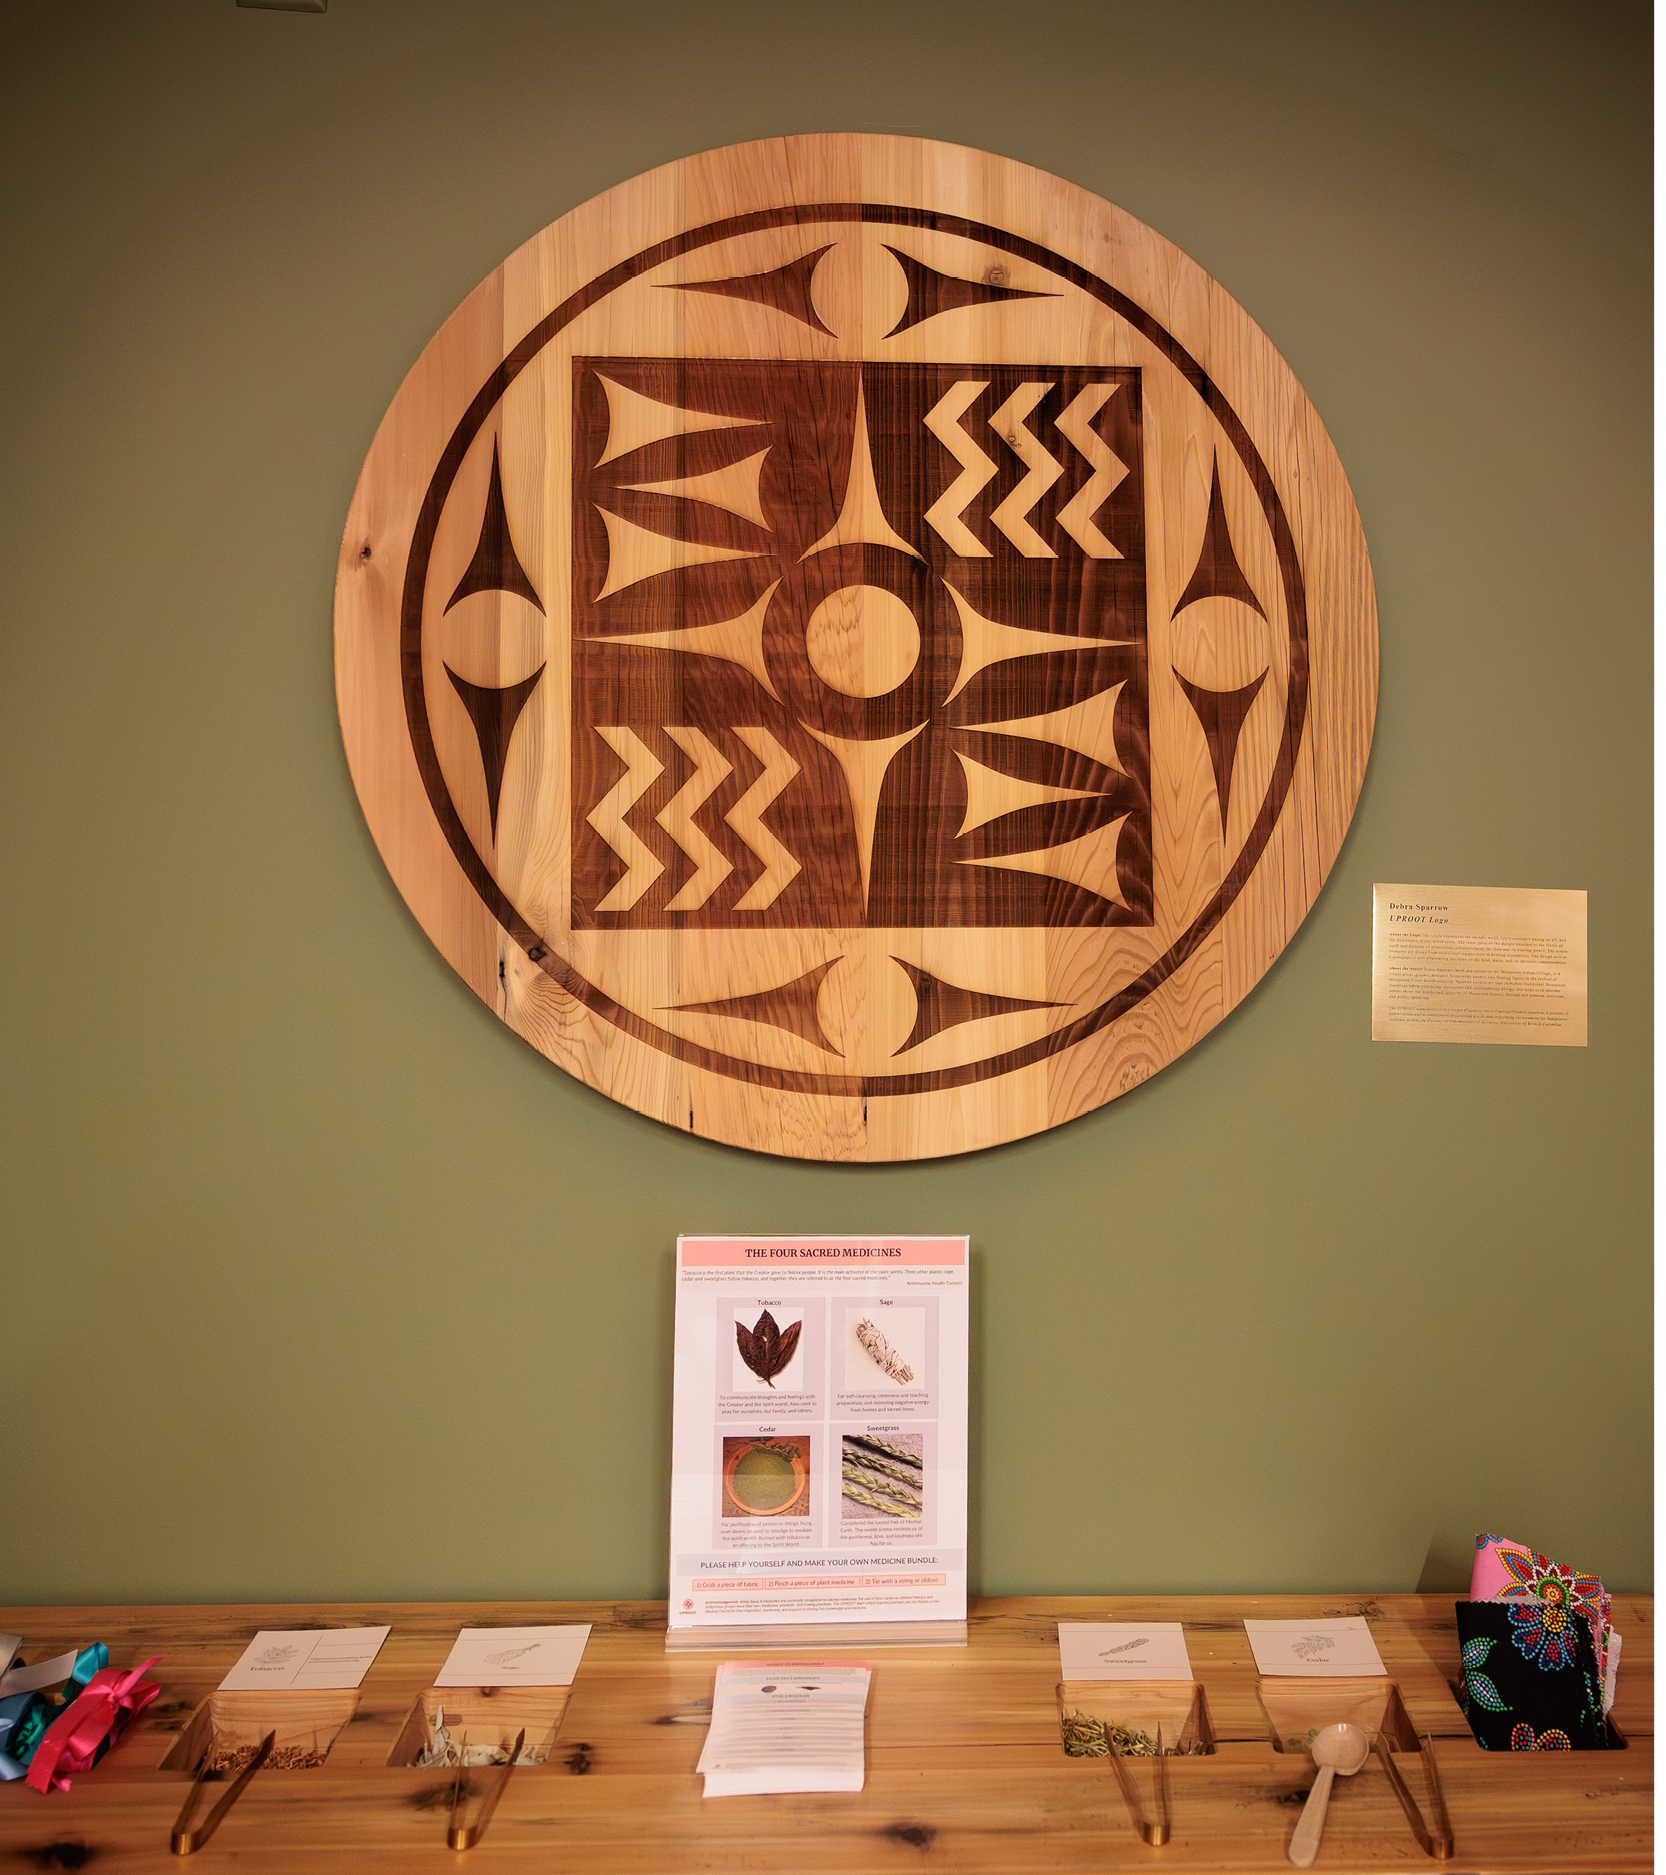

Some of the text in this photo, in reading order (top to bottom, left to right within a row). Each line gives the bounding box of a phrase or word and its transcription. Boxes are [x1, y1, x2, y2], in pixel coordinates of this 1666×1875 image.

[1415, 903, 1448, 912] Sparrow
[1428, 916, 1449, 925] Logo
[744, 1248, 902, 1258] THE FOUR SACRED MEDICINES
[879, 1299, 894, 1307] Sage
